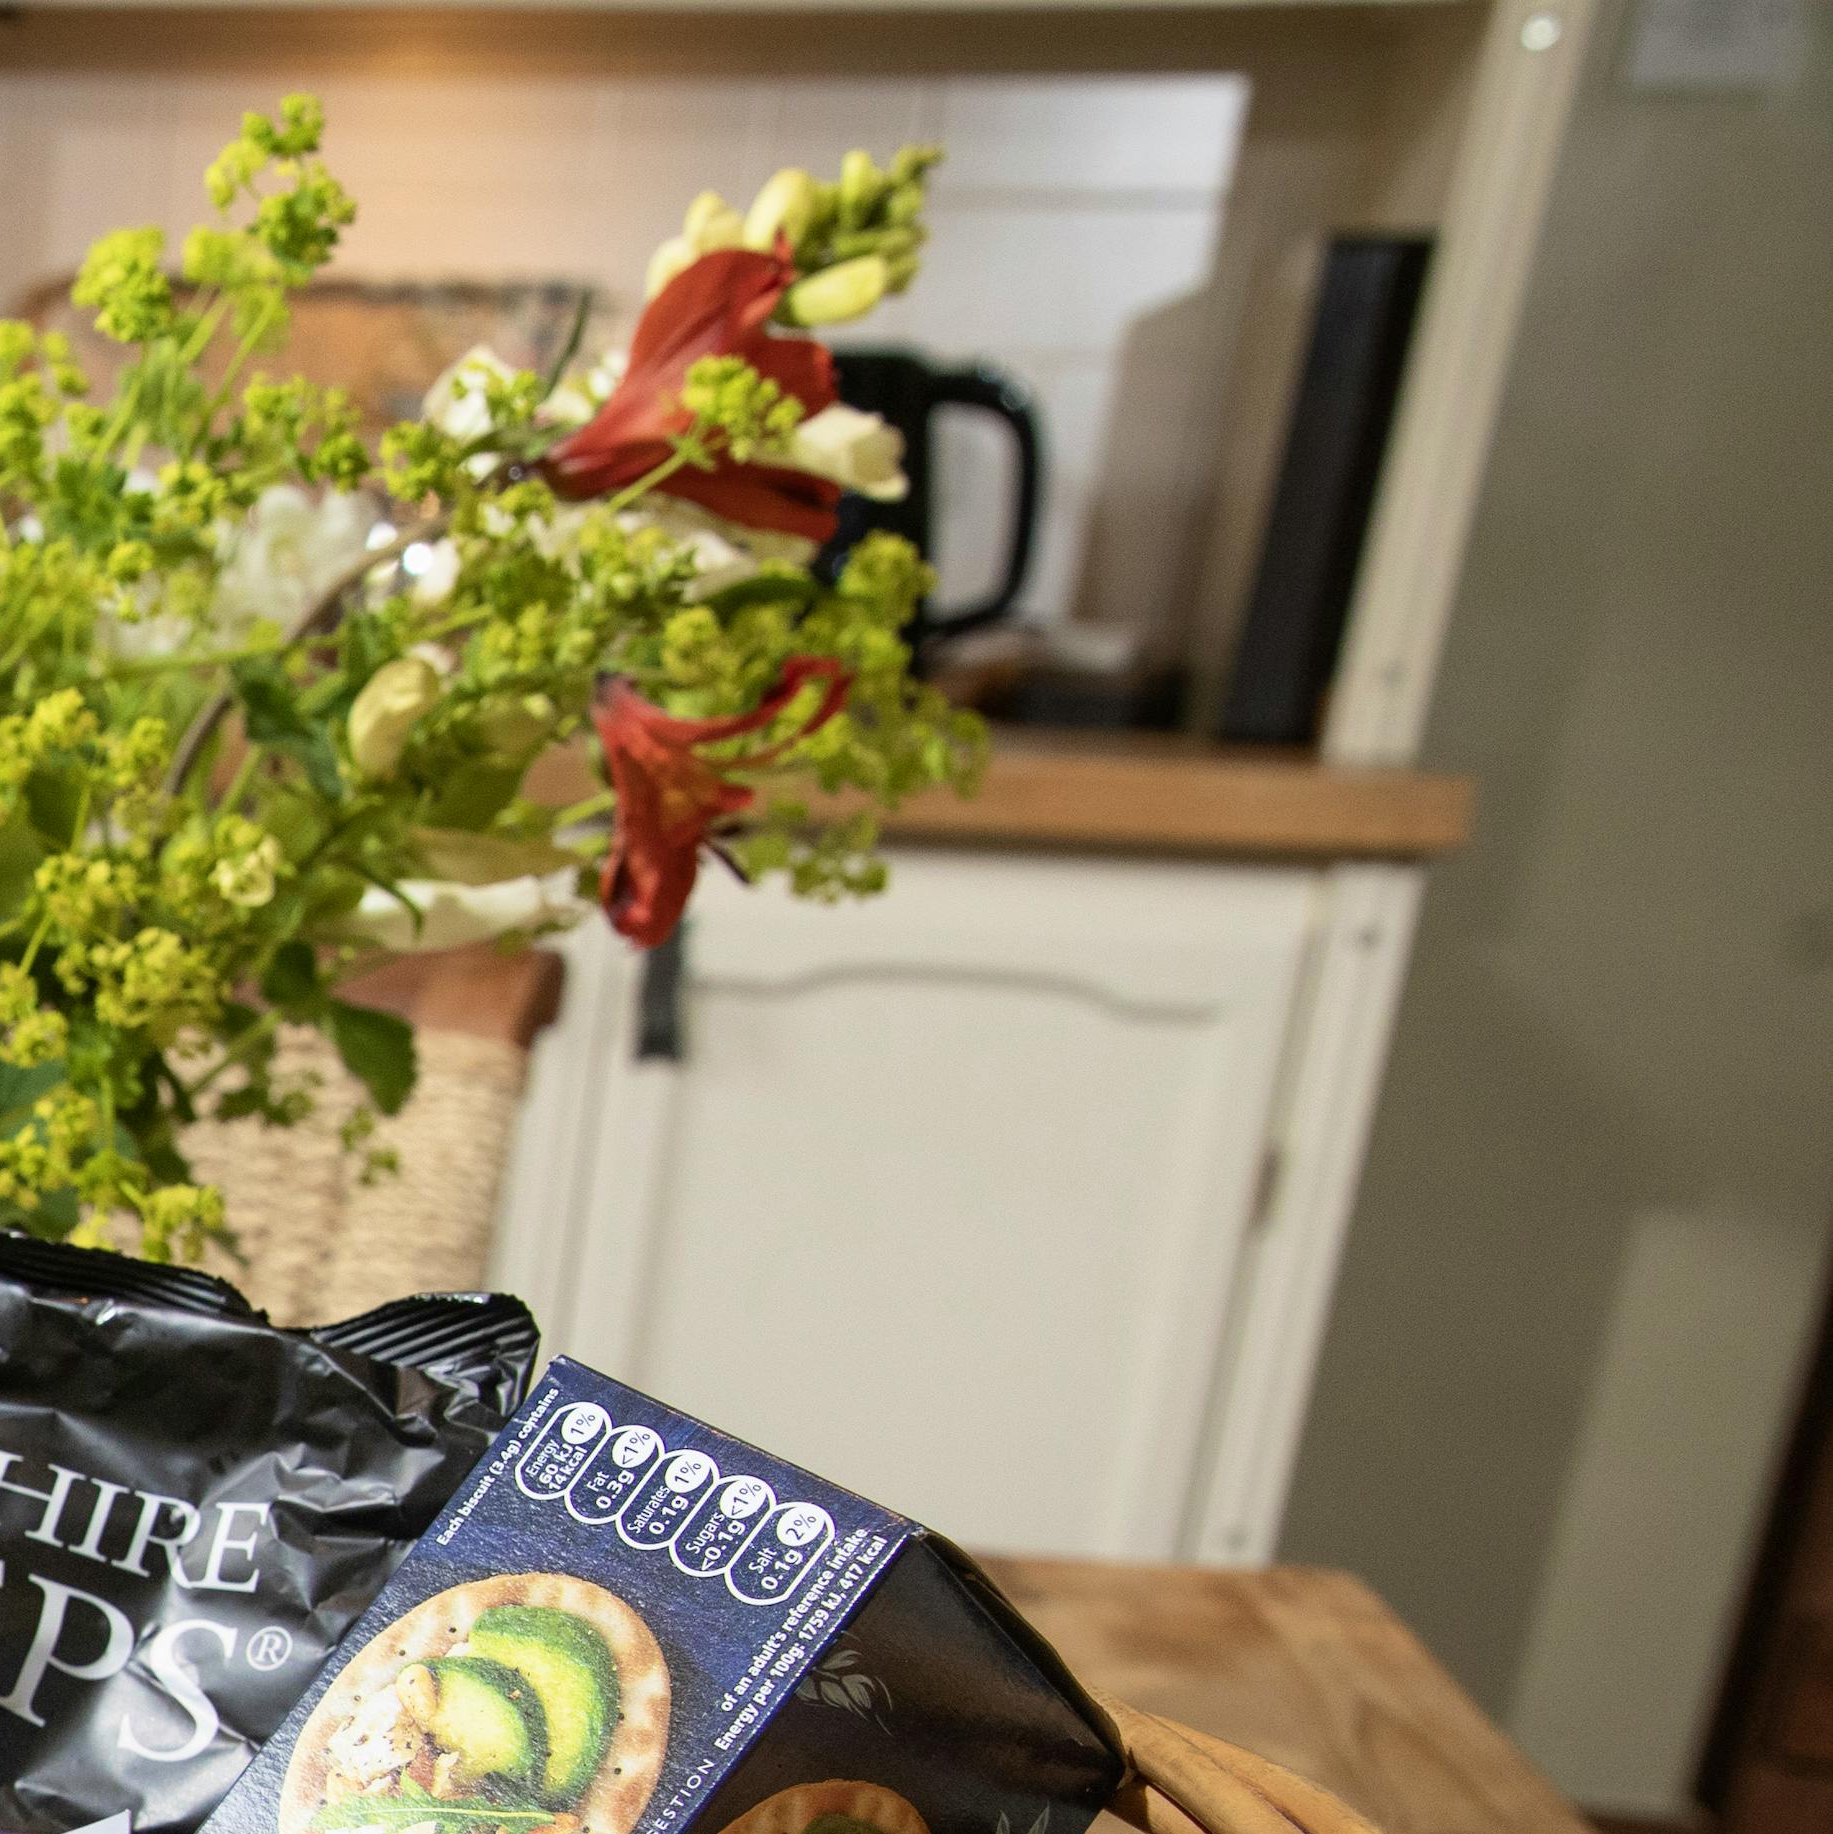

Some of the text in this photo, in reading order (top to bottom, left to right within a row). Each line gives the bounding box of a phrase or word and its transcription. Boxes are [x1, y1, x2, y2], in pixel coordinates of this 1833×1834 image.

[570, 1413, 595, 1437] 1%
[436, 1387, 560, 1546] Each biscuit (3.4g) contains
[525, 1439, 560, 1476] Energy
[539, 1443, 574, 1484] 60 kJ
[622, 1432, 651, 1465] <1%
[586, 1471, 610, 1491] Fat
[596, 1470, 635, 1509] 0.3g
[674, 1462, 702, 1484] 1%
[627, 1485, 671, 1534] Saturates
[648, 1495, 689, 1535] 0.1g
[731, 1482, 762, 1516] <1%
[685, 1511, 725, 1554] Sugars
[701, 1519, 746, 1571] <0.1g
[785, 1513, 817, 1541] 2%
[748, 1547, 778, 1574] Salt
[760, 1549, 803, 1590] 0.1g
[720, 1528, 868, 1712] of an adult's reference intake
[714, 1535, 888, 1751] Energy per 100g: 1759 kJ, 417 kcal
